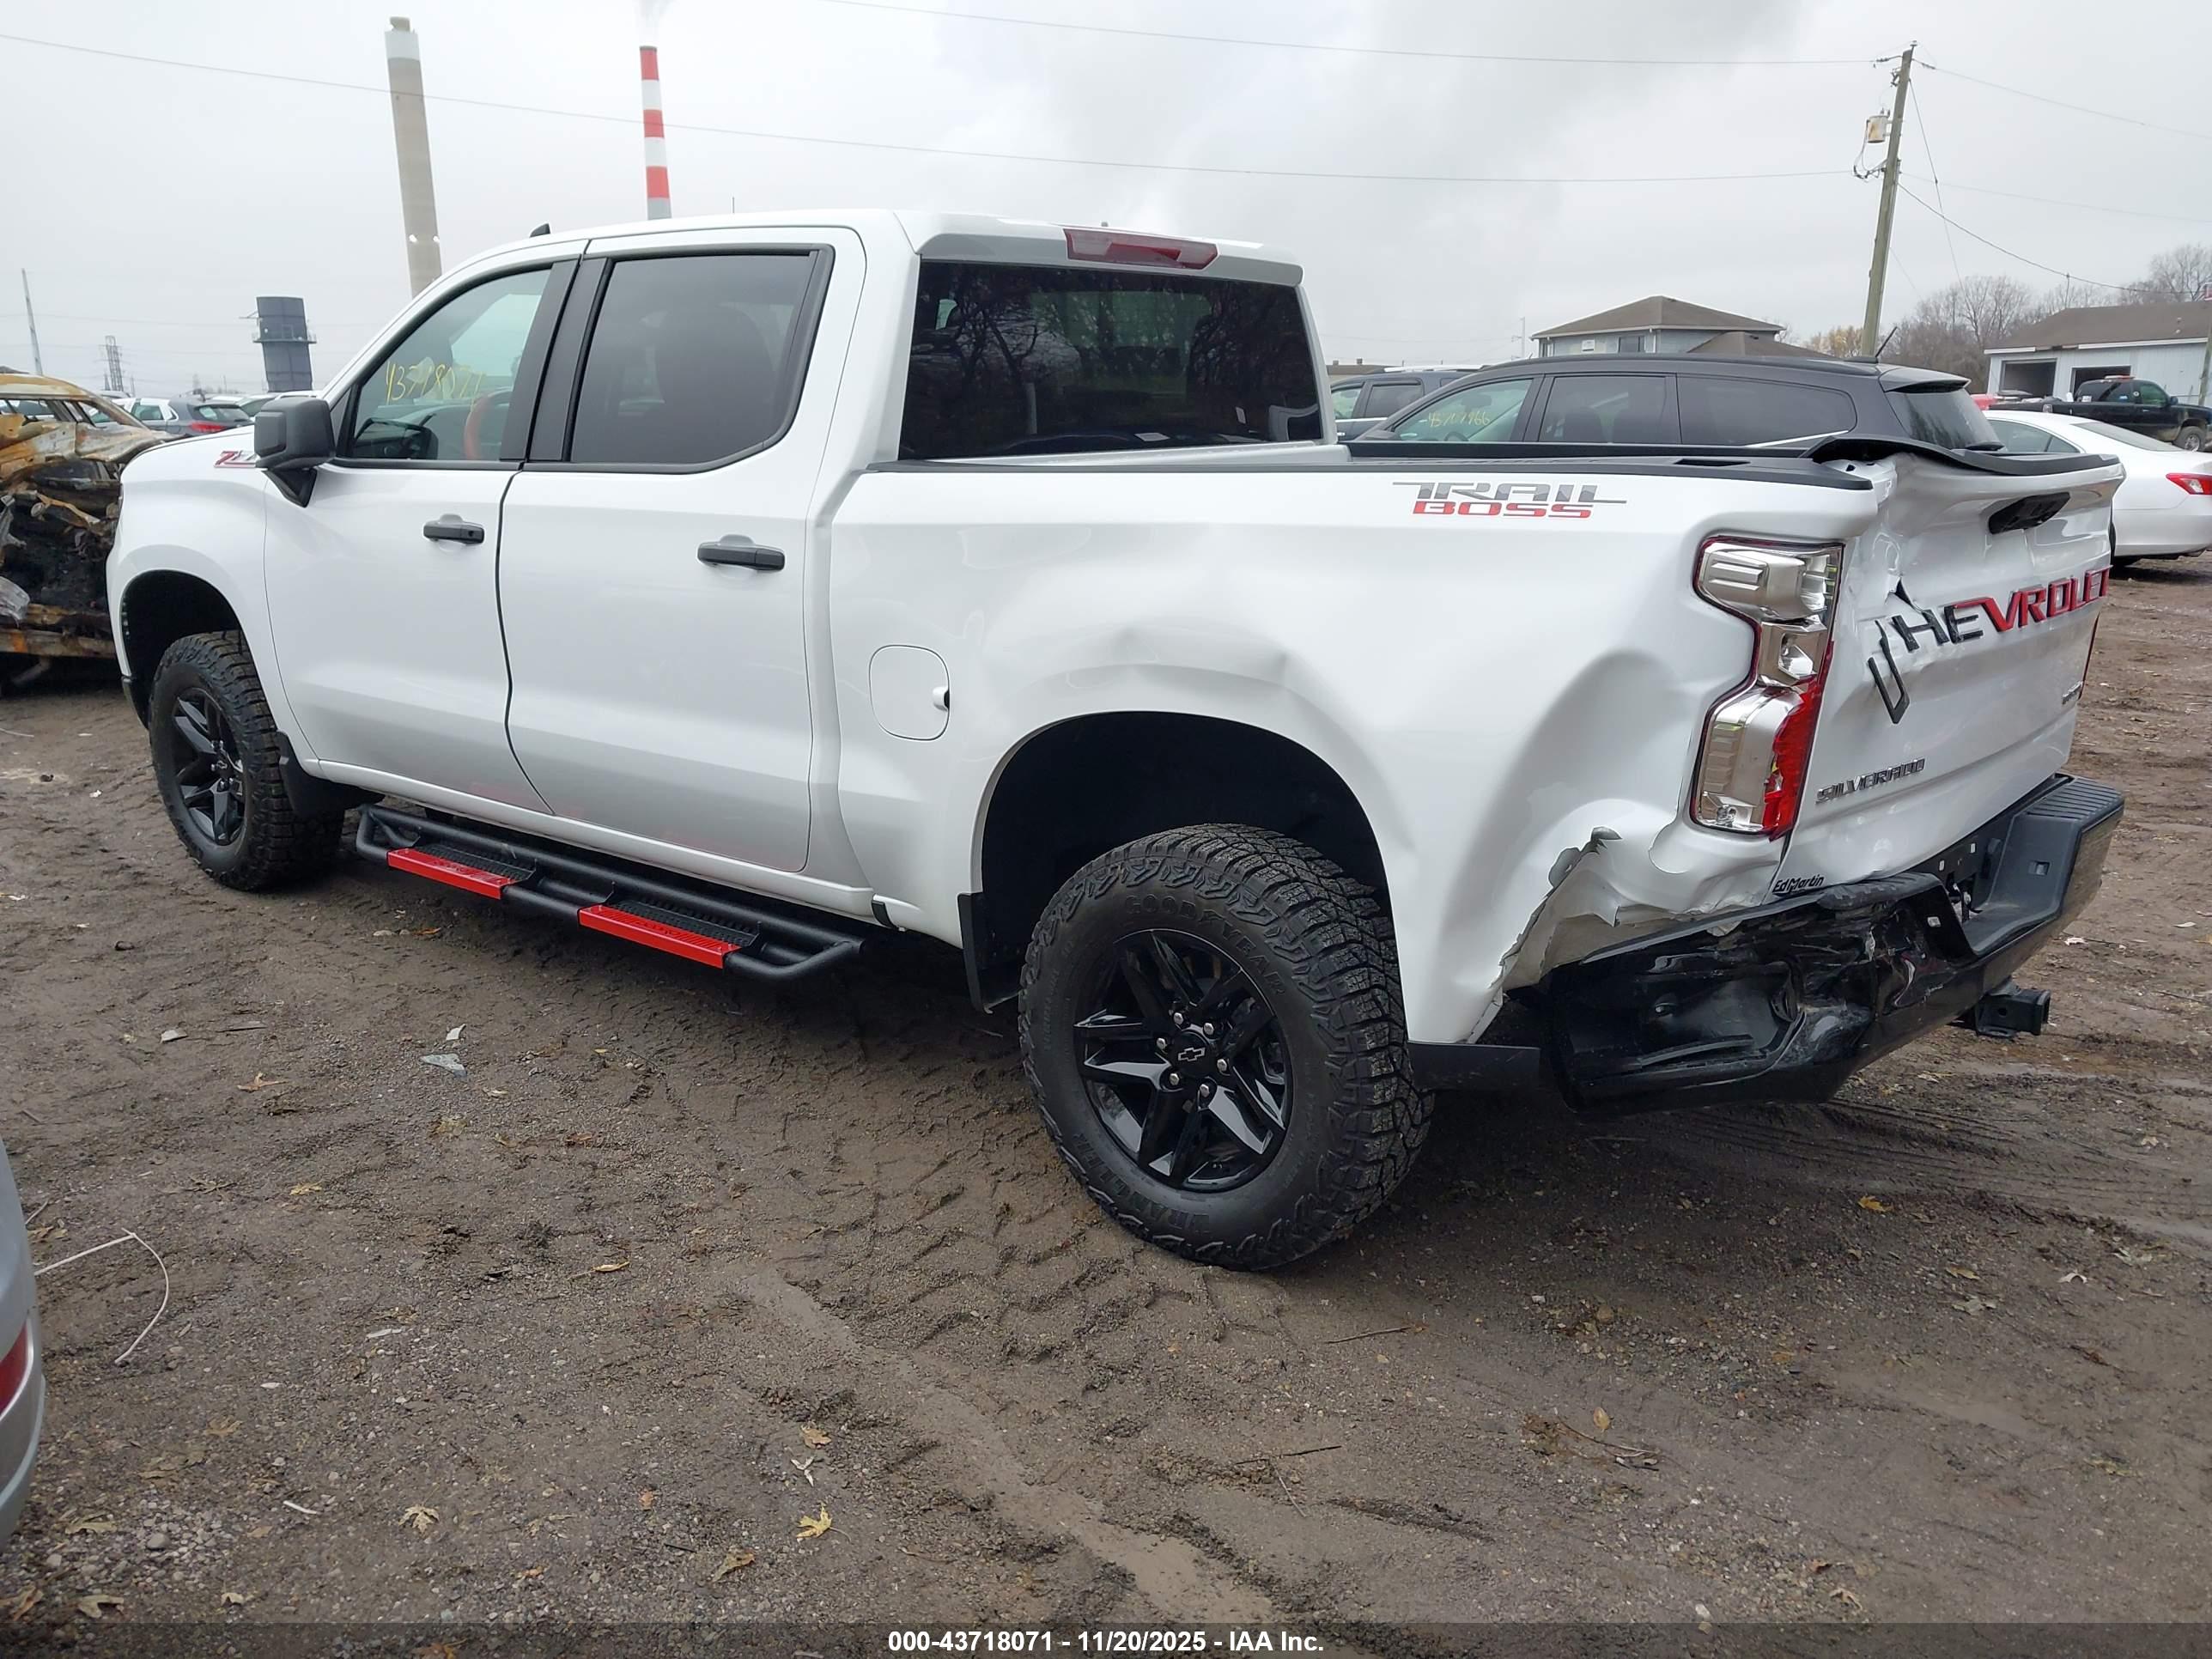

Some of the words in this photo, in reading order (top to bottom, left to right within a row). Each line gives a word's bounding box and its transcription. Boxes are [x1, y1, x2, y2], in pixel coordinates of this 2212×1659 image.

[1392, 482, 1627, 504] TRAIL
[1413, 501, 1594, 519] BOSS
[1815, 758, 1925, 804] SILVERADO
